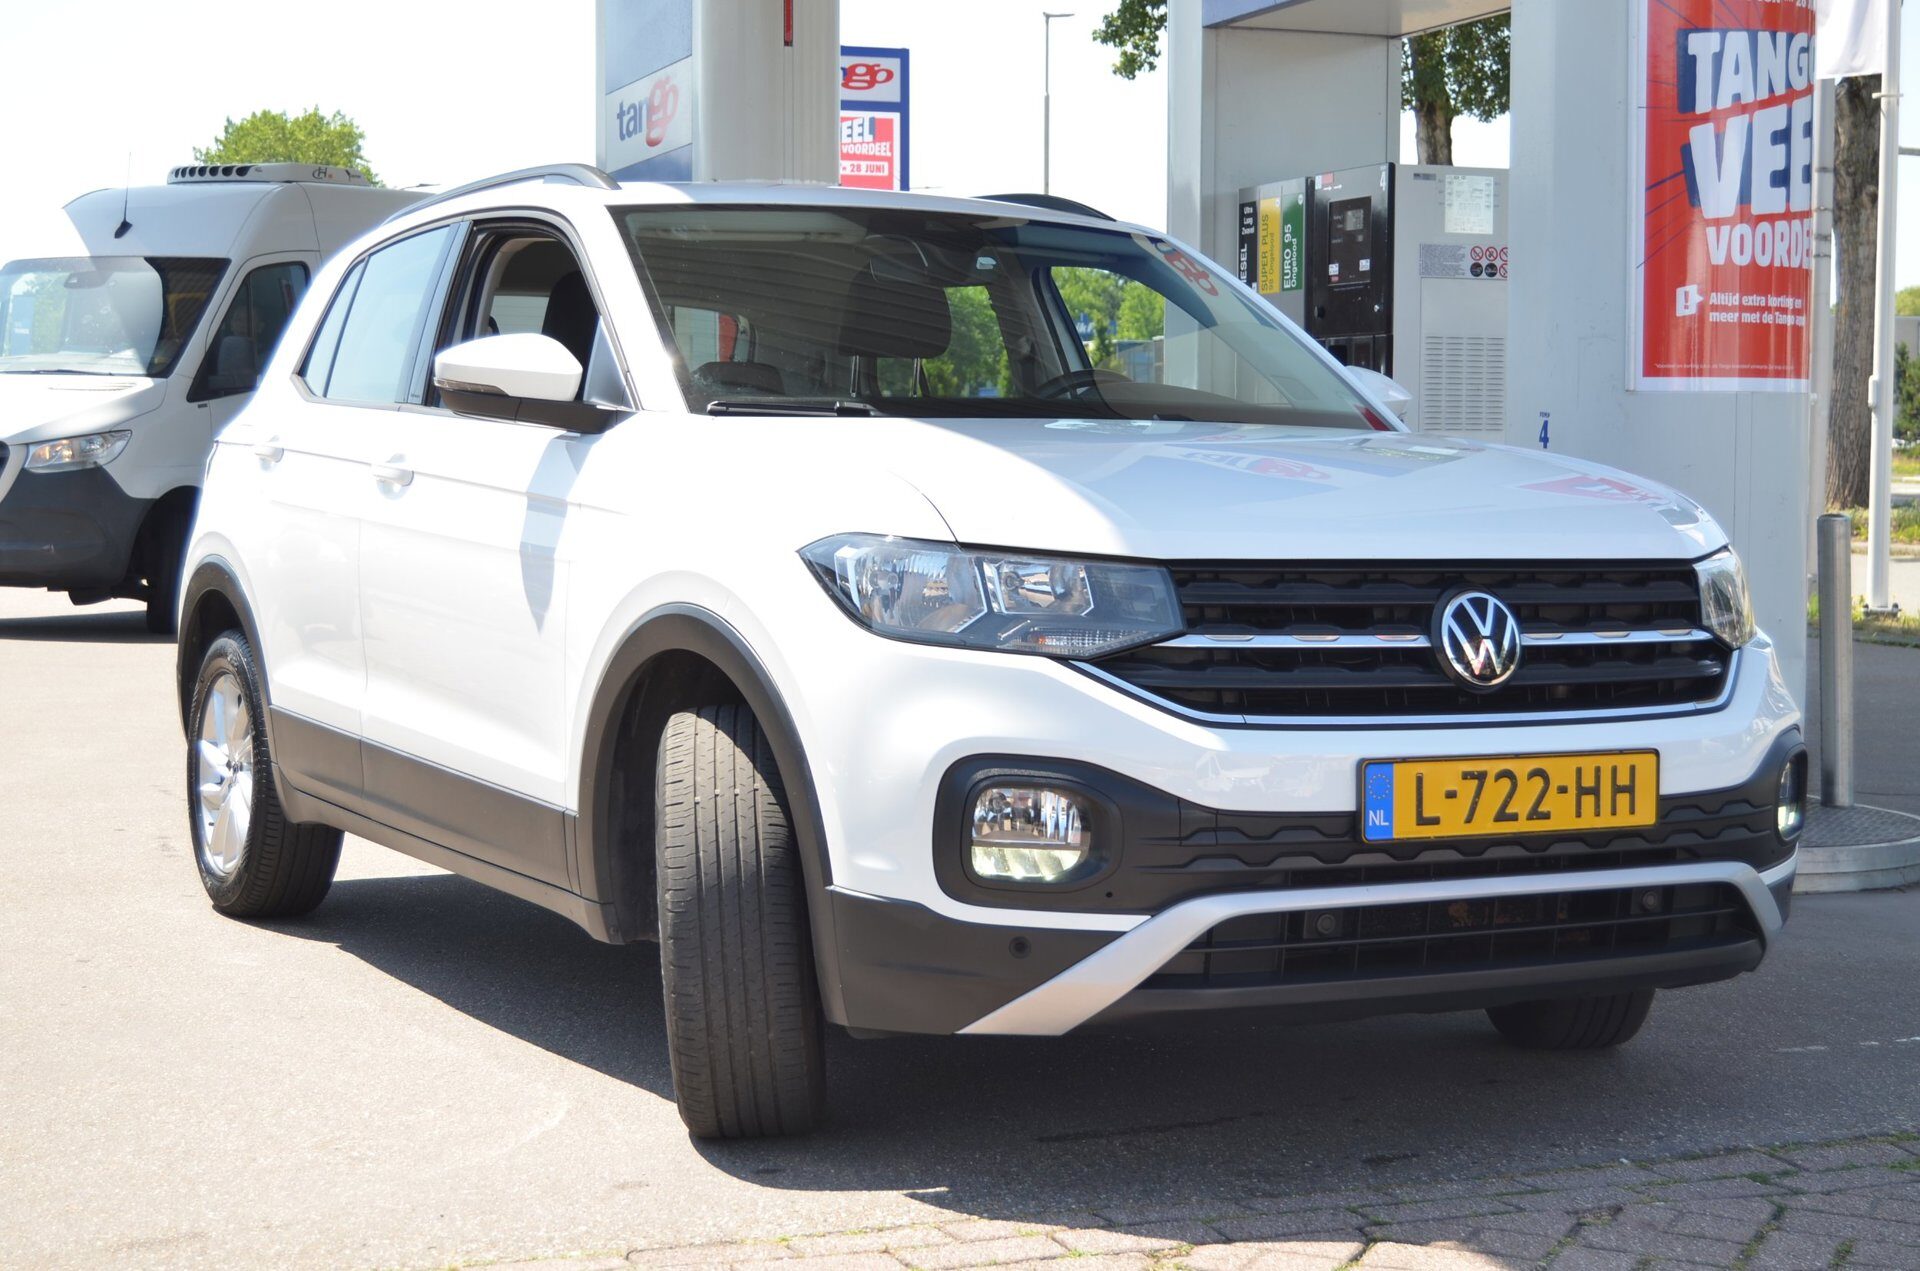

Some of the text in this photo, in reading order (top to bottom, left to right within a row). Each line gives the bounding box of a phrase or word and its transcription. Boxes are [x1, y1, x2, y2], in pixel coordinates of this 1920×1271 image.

[616, 75, 679, 147] tango
[841, 117, 874, 142] EEL
[841, 142, 892, 157] VOORDEEL
[1689, 95, 1812, 219] VEE
[850, 163, 862, 173] 28
[865, 164, 885, 174] JUNI
[1379, 171, 1386, 191] 4
[1261, 214, 1269, 291] SUPER PLUS
[1283, 223, 1292, 289] EURO 95
[1706, 221, 1812, 268] VOORDE
[1709, 292, 1739, 306] Altijd
[1742, 294, 1766, 306] extra
[1768, 294, 1794, 310] korting
[1709, 312, 1739, 323] meer
[1741, 313, 1760, 324] met
[1762, 312, 1773, 324] de
[1774, 311, 1795, 327] Tango
[1538, 420, 1550, 449] 4
[1415, 764, 1636, 826] L-722-HH
[1368, 809, 1390, 827] NL
